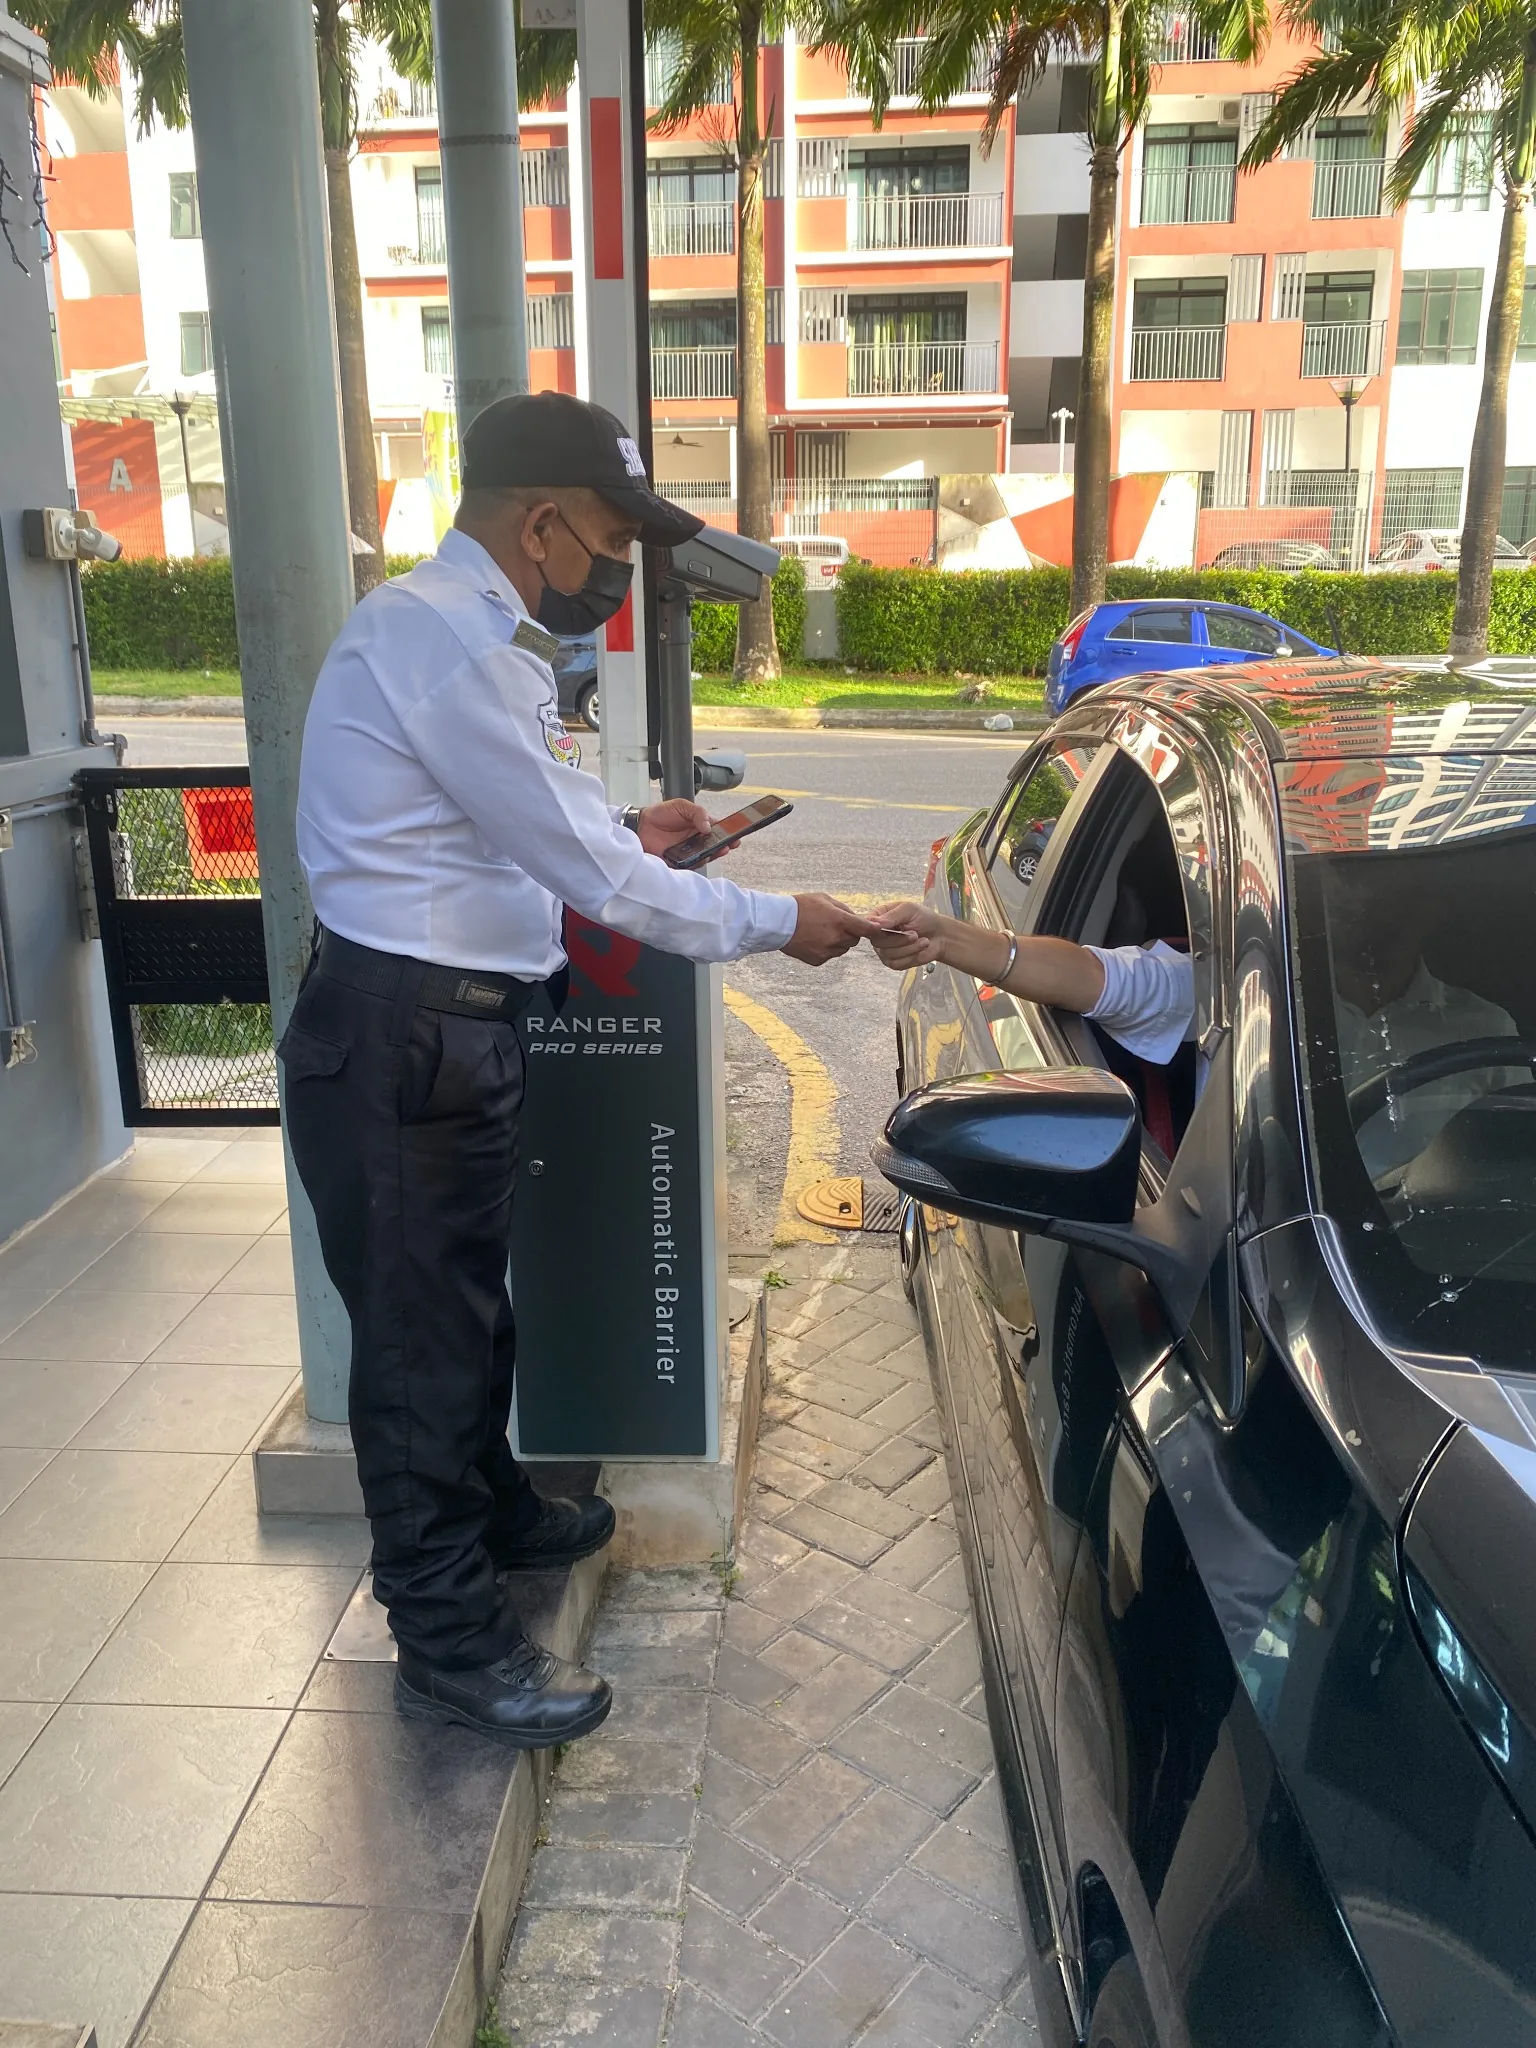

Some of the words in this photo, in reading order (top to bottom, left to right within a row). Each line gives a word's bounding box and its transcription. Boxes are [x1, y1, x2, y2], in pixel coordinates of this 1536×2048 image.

[109, 457, 133, 492] A
[526, 1016, 663, 1034] RANGER
[529, 1042, 576, 1054] PRO
[582, 1043, 663, 1055] SERIES
[650, 1122, 678, 1275] Automatic
[654, 1287, 680, 1383] Barrier
